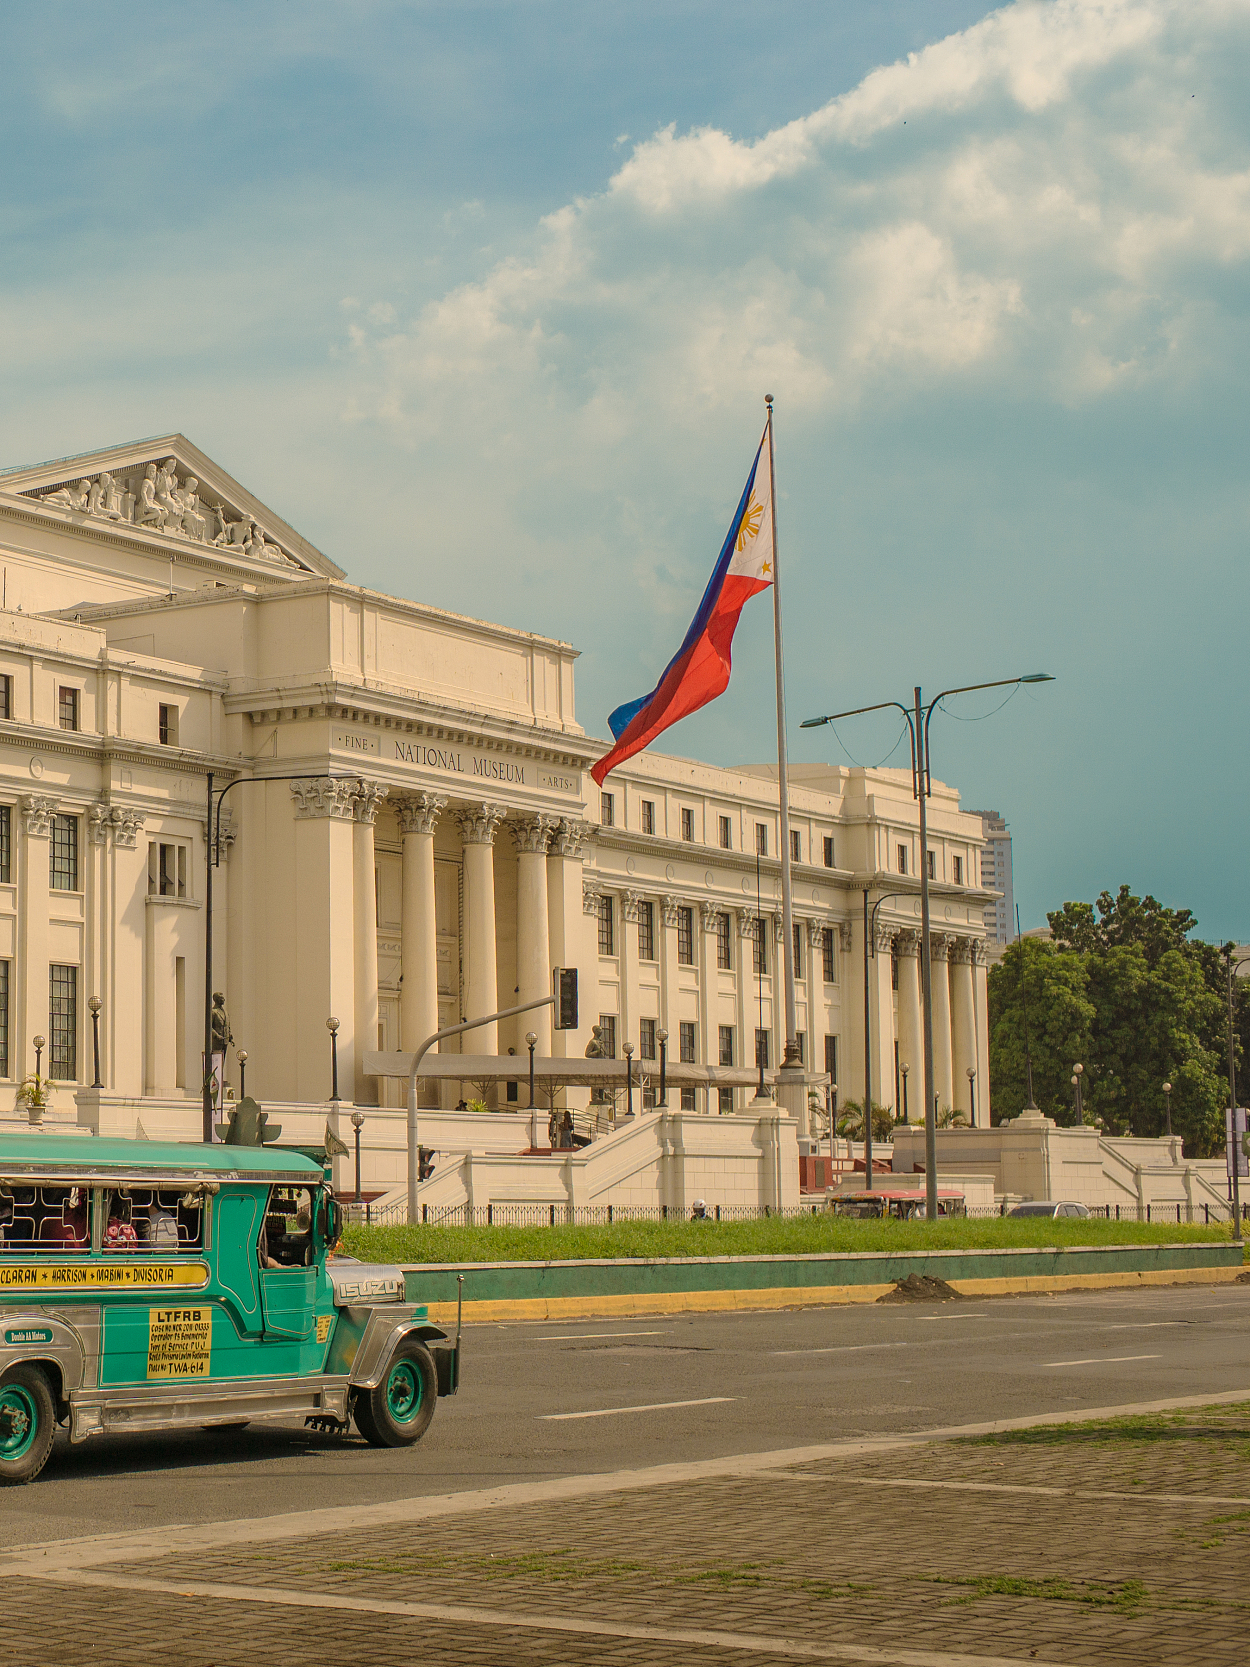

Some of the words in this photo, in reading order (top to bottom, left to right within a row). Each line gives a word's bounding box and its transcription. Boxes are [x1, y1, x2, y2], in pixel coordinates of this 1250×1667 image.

[345, 735, 368, 750] FINE
[394, 741, 464, 772] NATIONAL
[473, 757, 525, 784] MUSEUM
[547, 776, 569, 789] ARTS
[52, 1268, 87, 1283] HARRISON
[96, 1268, 124, 1282] MABINI
[133, 1268, 174, 1282] DIVISORIA
[340, 1280, 398, 1298] ISUZU
[158, 1311, 201, 1322] LTFRB
[11, 1332, 25, 1341] Double
[26, 1332, 31, 1340] AA
[32, 1332, 46, 1340] Motors
[168, 1362, 204, 1374] TWA-614
